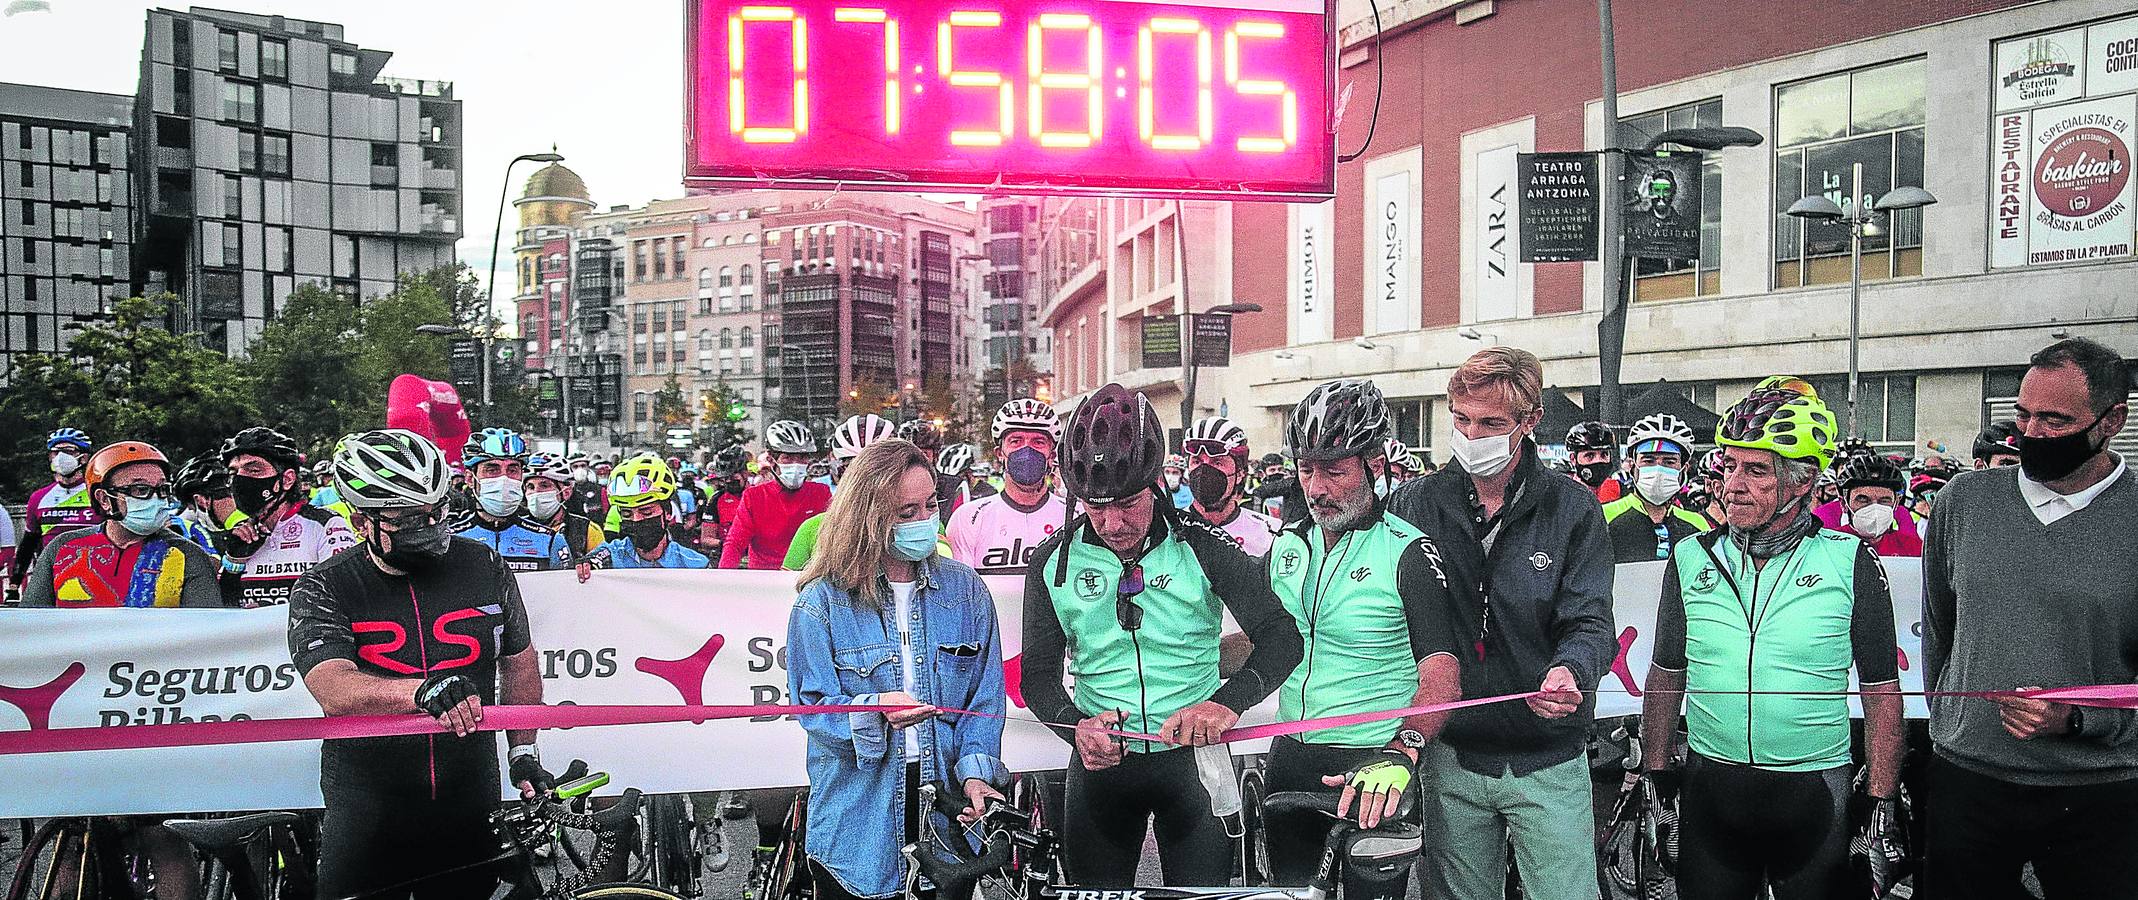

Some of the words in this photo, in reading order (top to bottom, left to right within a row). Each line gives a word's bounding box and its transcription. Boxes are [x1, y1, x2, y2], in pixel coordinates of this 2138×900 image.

[728, 6, 1297, 150] 07:58:05
[2018, 64, 2059, 79] BODEGA
[2019, 77, 2058, 91] Estrella
[2019, 87, 2055, 101] Galicia
[2038, 114, 2113, 145] ESPECIALISTAS
[2112, 119, 2129, 134] EN
[1530, 174, 1586, 186] ARRIAGA
[1534, 161, 1582, 173] TEATRO
[1823, 170, 1840, 189] La
[1999, 115, 2022, 239] RESTAURANTE
[2041, 151, 2123, 184] baskian
[1527, 187, 1590, 199] ANTZOKIA
[1487, 183, 1507, 279] ZARA
[2036, 211, 2071, 232] BRASAS
[2072, 220, 2085, 232] AL
[2087, 201, 2126, 230] CARBÓN
[1385, 201, 1398, 300] MANGO
[2031, 250, 2064, 263] ESTAMOS
[2066, 248, 2077, 260] EN
[2077, 247, 2087, 259] LA
[2099, 243, 2128, 257] PLANTA
[1304, 226, 1314, 313] PRIMOR
[542, 646, 618, 680] ros
[103, 661, 296, 705] Seguros
[1055, 889, 1147, 900] TREK
